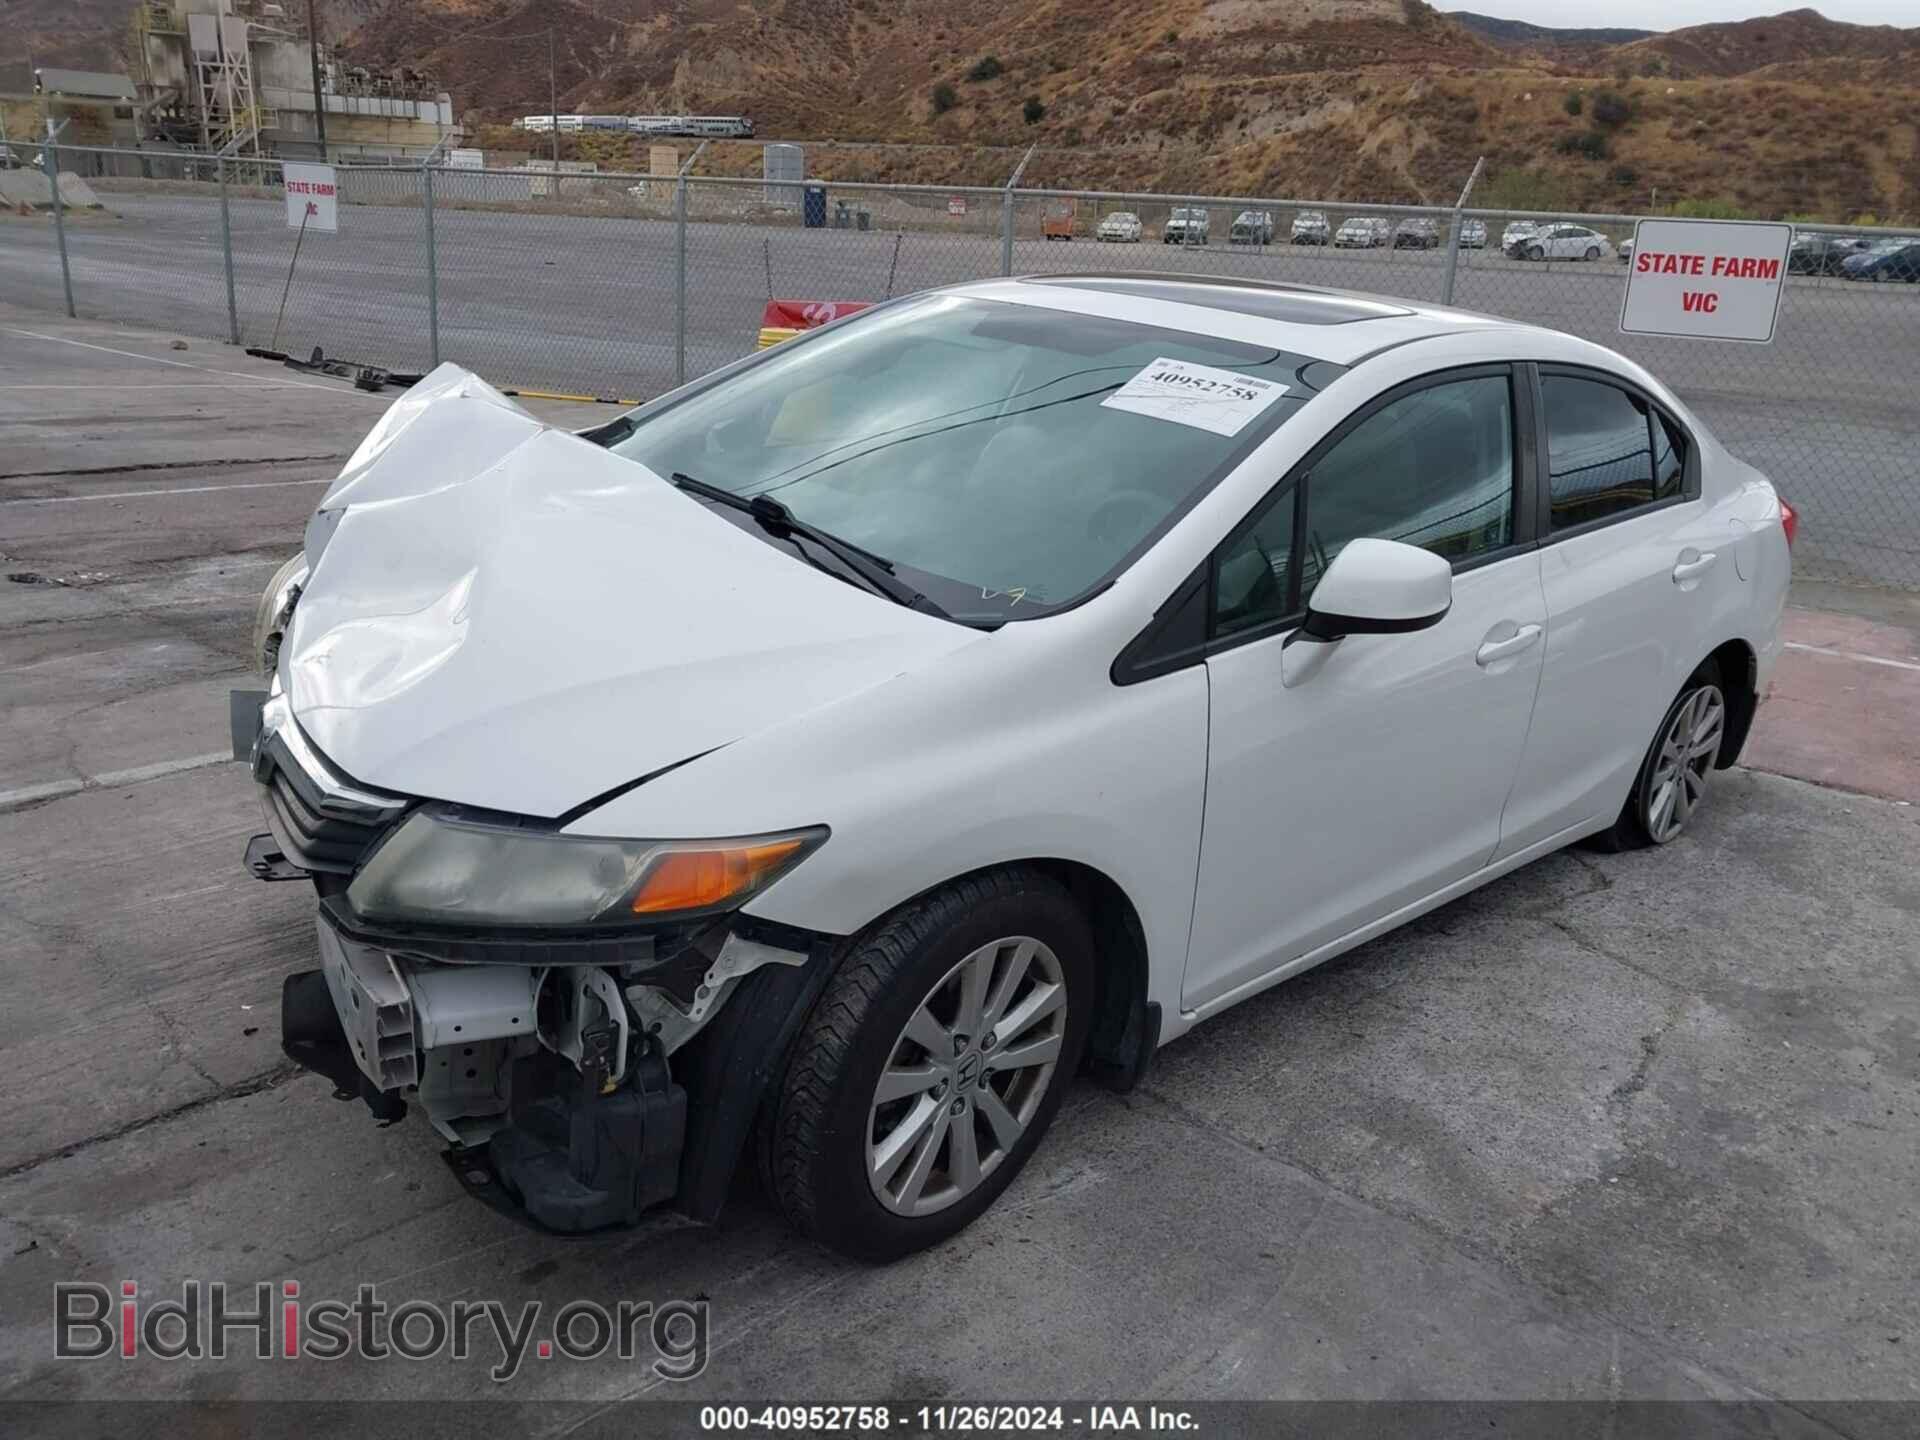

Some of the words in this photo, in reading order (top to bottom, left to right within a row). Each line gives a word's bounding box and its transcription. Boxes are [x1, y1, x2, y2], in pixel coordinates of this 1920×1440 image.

[287, 182, 310, 194] STATE
[312, 184, 334, 196] FARM
[1637, 253, 1705, 275] STATE
[1711, 256, 1779, 279] FARM
[1682, 291, 1718, 313] VIC
[1151, 371, 1258, 401] 40952758
